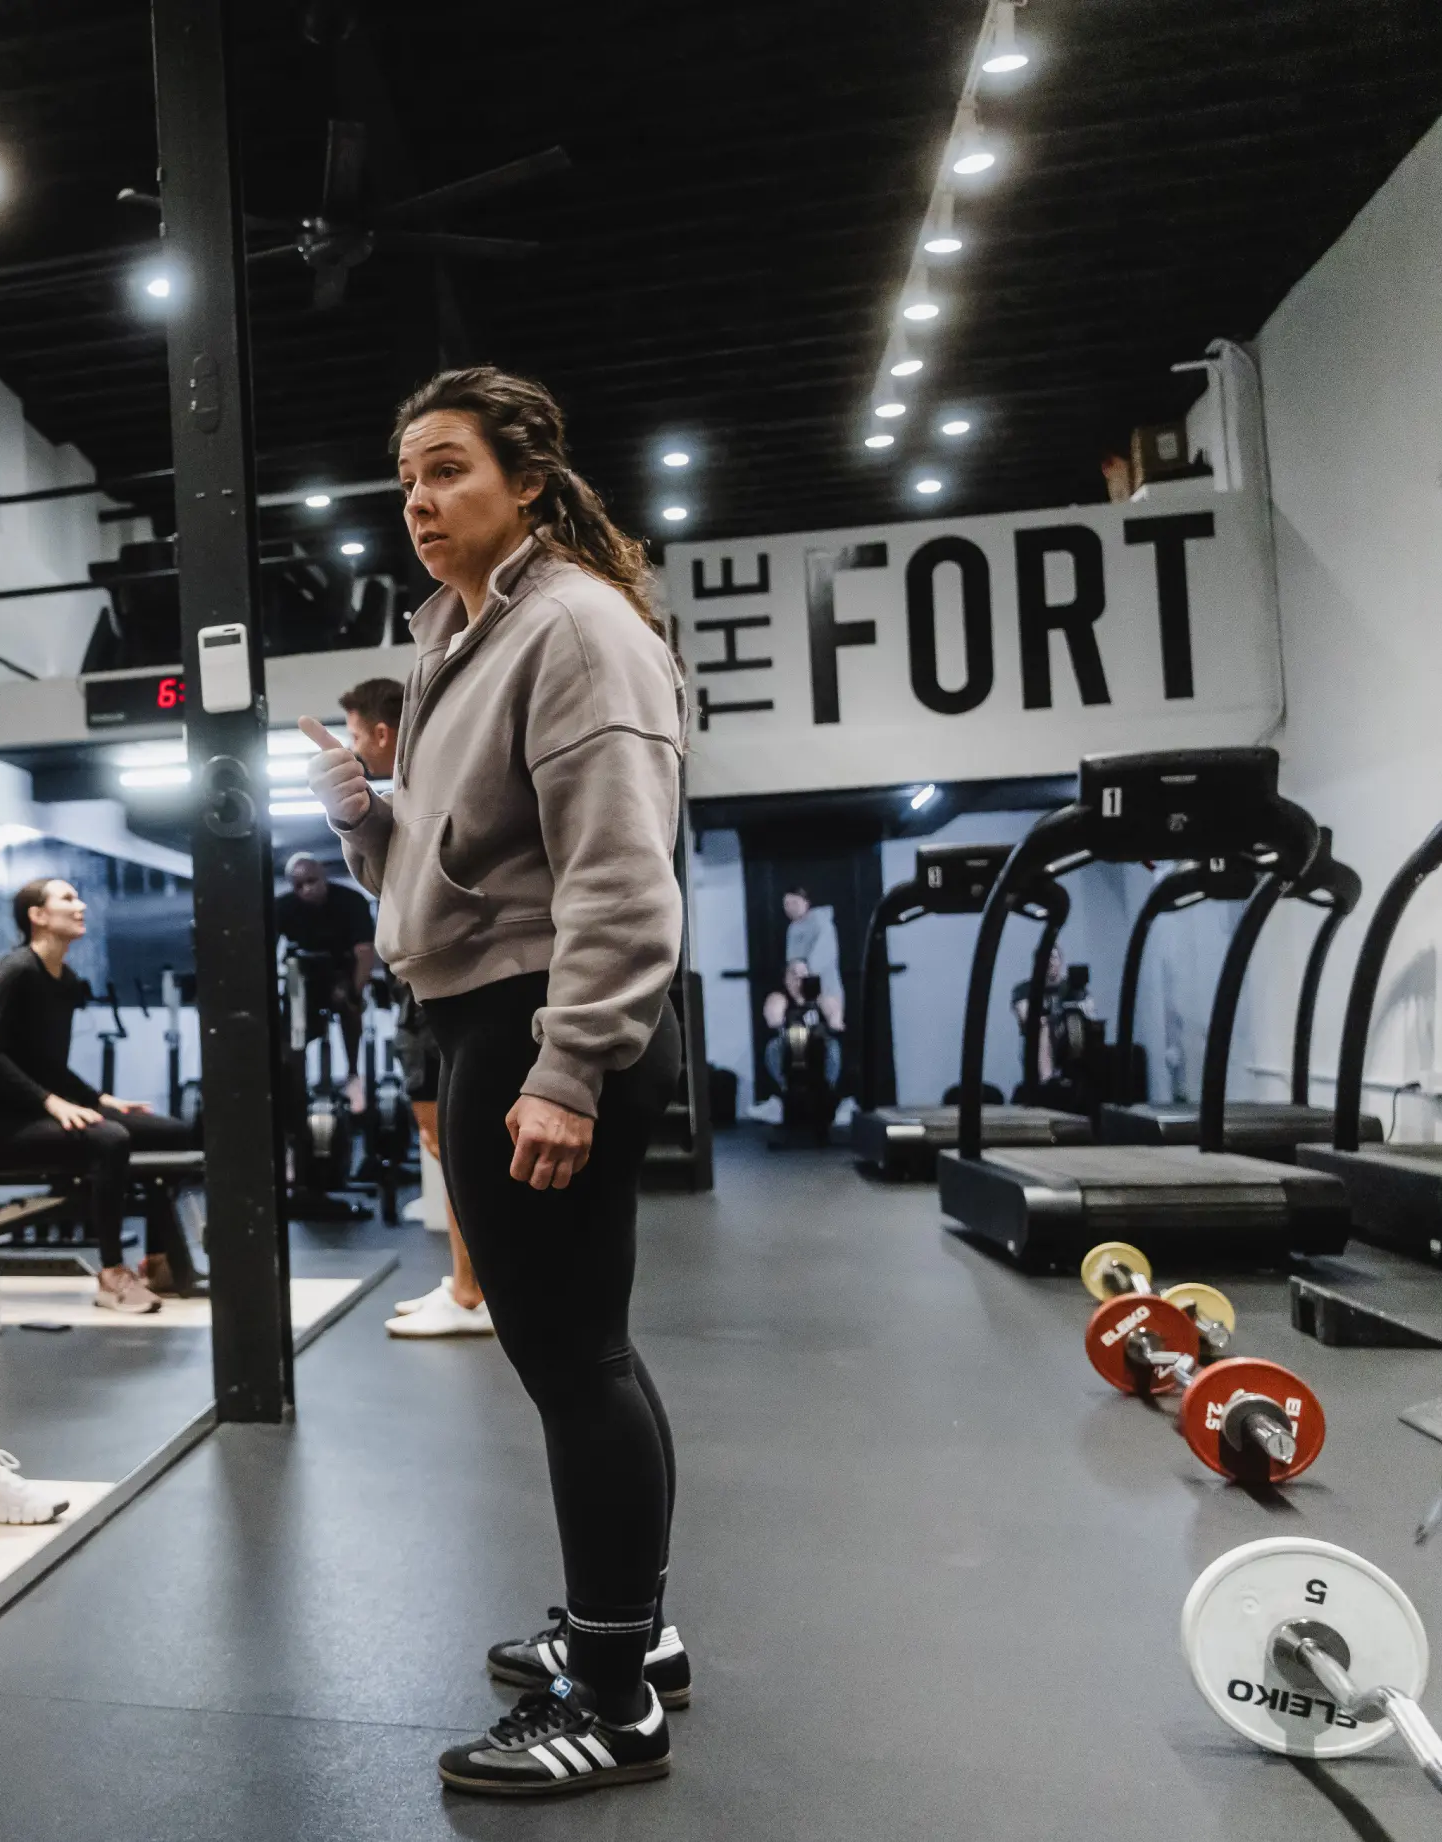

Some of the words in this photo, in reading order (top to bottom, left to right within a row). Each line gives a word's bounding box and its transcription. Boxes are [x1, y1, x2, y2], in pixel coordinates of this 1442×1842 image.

[804, 510, 1217, 726] FORT
[691, 552, 775, 732] THE
[1100, 1304, 1151, 1347] ELEIKO
[1205, 1401, 1225, 1431] 2.5
[1304, 1578, 1329, 1605] 5
[1227, 1678, 1358, 1730] ELEIKO
